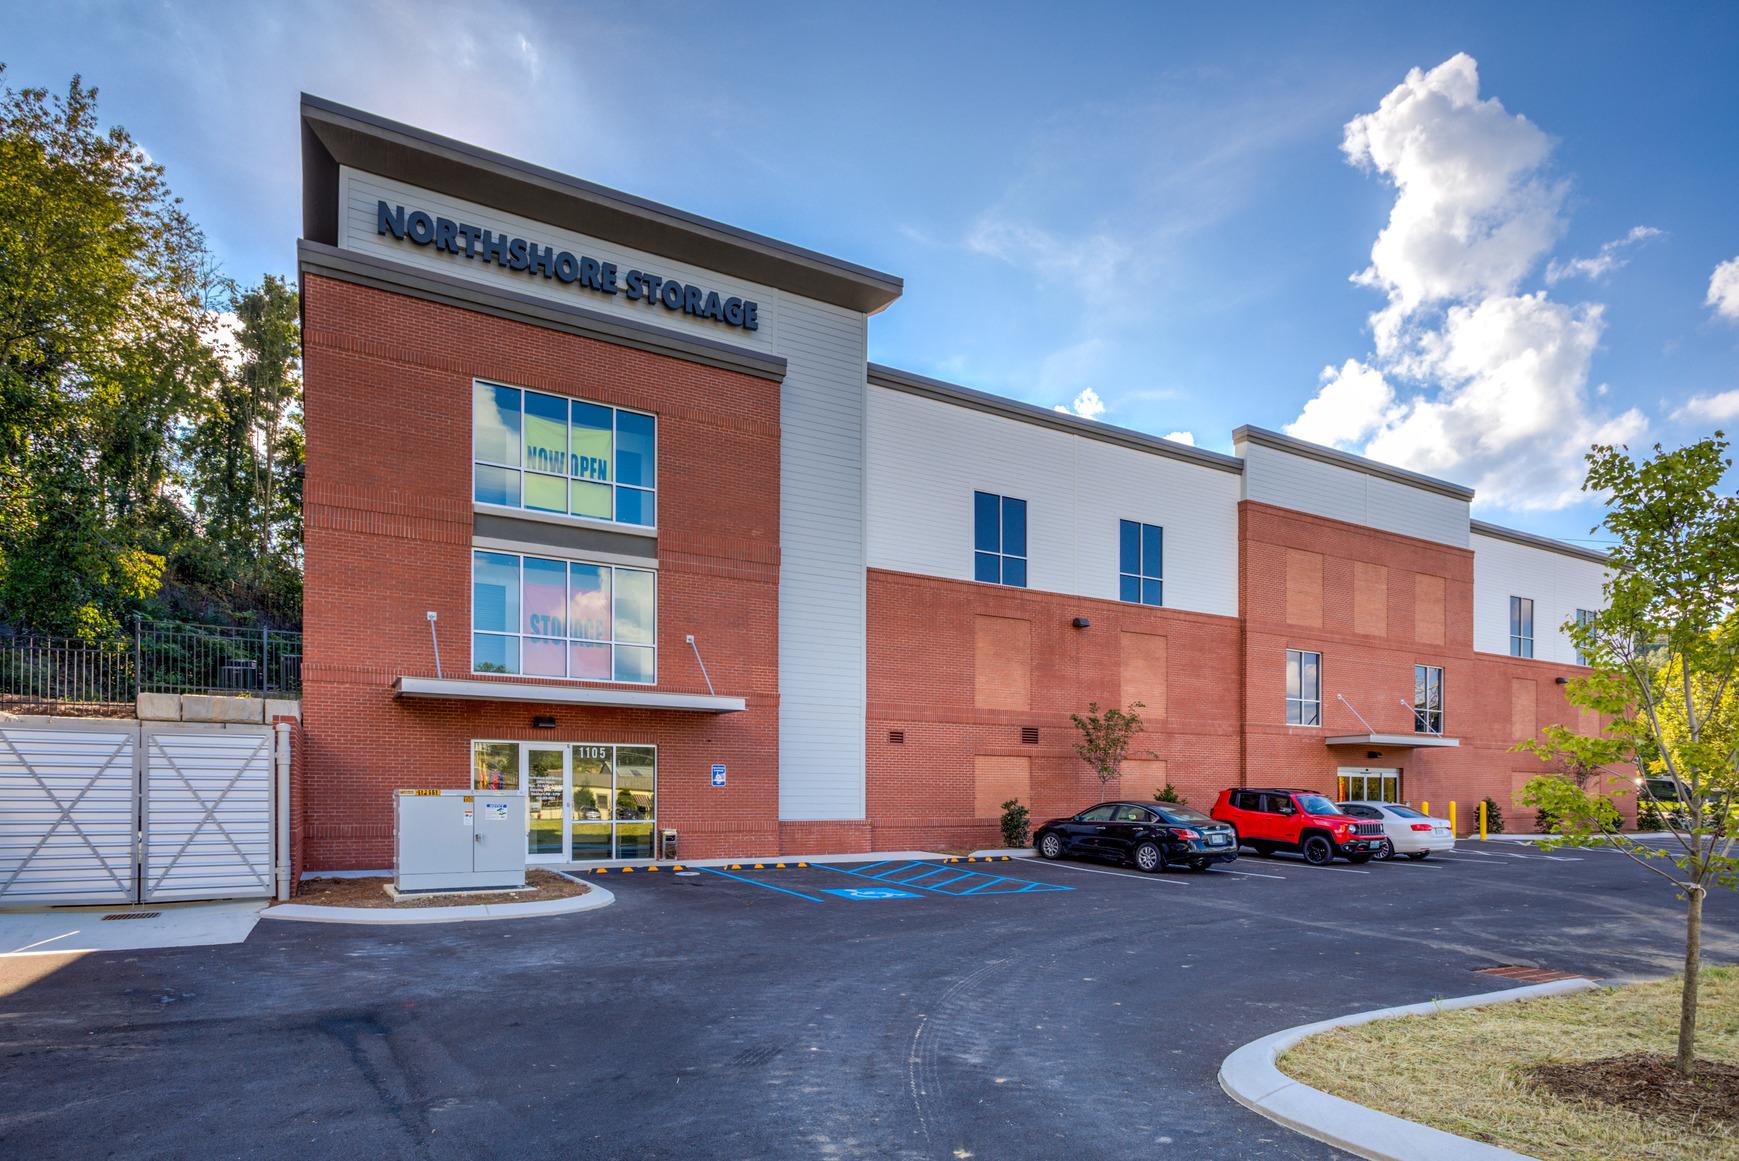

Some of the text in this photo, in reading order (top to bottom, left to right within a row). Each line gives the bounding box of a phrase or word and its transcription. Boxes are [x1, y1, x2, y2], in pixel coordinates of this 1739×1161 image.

[377, 200, 759, 331] NORTHSHORE STORAGE
[527, 445, 607, 481] NOW OPEN
[579, 746, 606, 759] 1105
